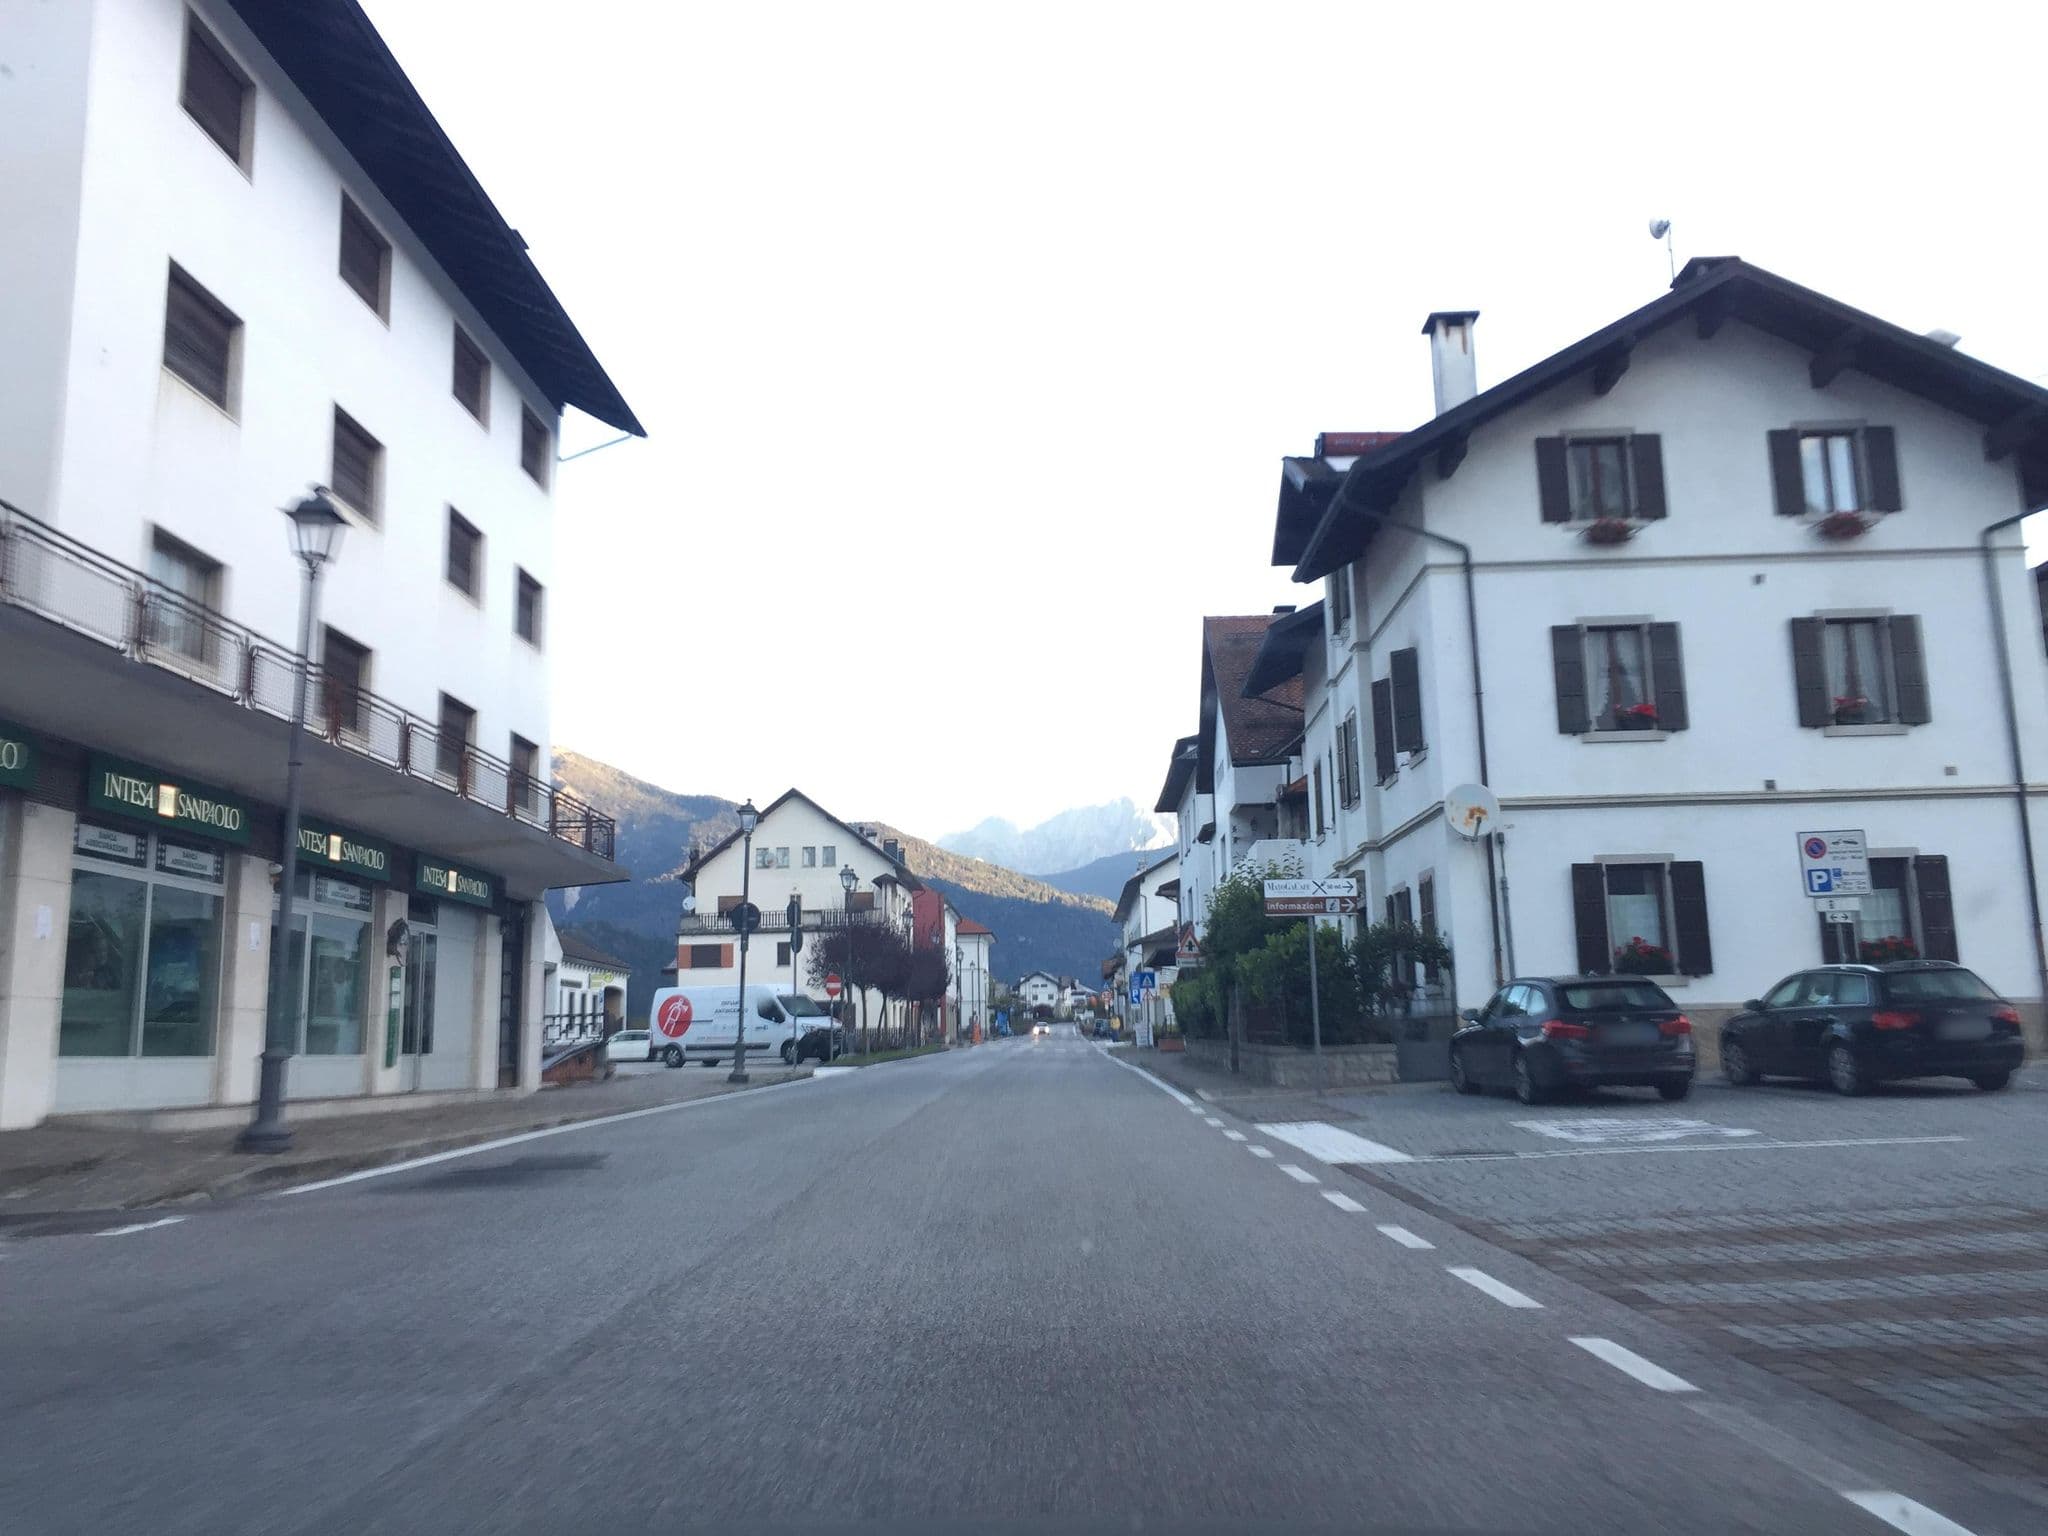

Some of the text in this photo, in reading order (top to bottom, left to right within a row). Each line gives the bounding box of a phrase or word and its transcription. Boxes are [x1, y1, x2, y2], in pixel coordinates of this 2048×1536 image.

[104, 772, 240, 831] INTESA SANPAOLO
[295, 827, 384, 870] NTESA SANPAOLO
[423, 865, 488, 898] INTESA SANPAOLO
[1811, 870, 1829, 891] P
